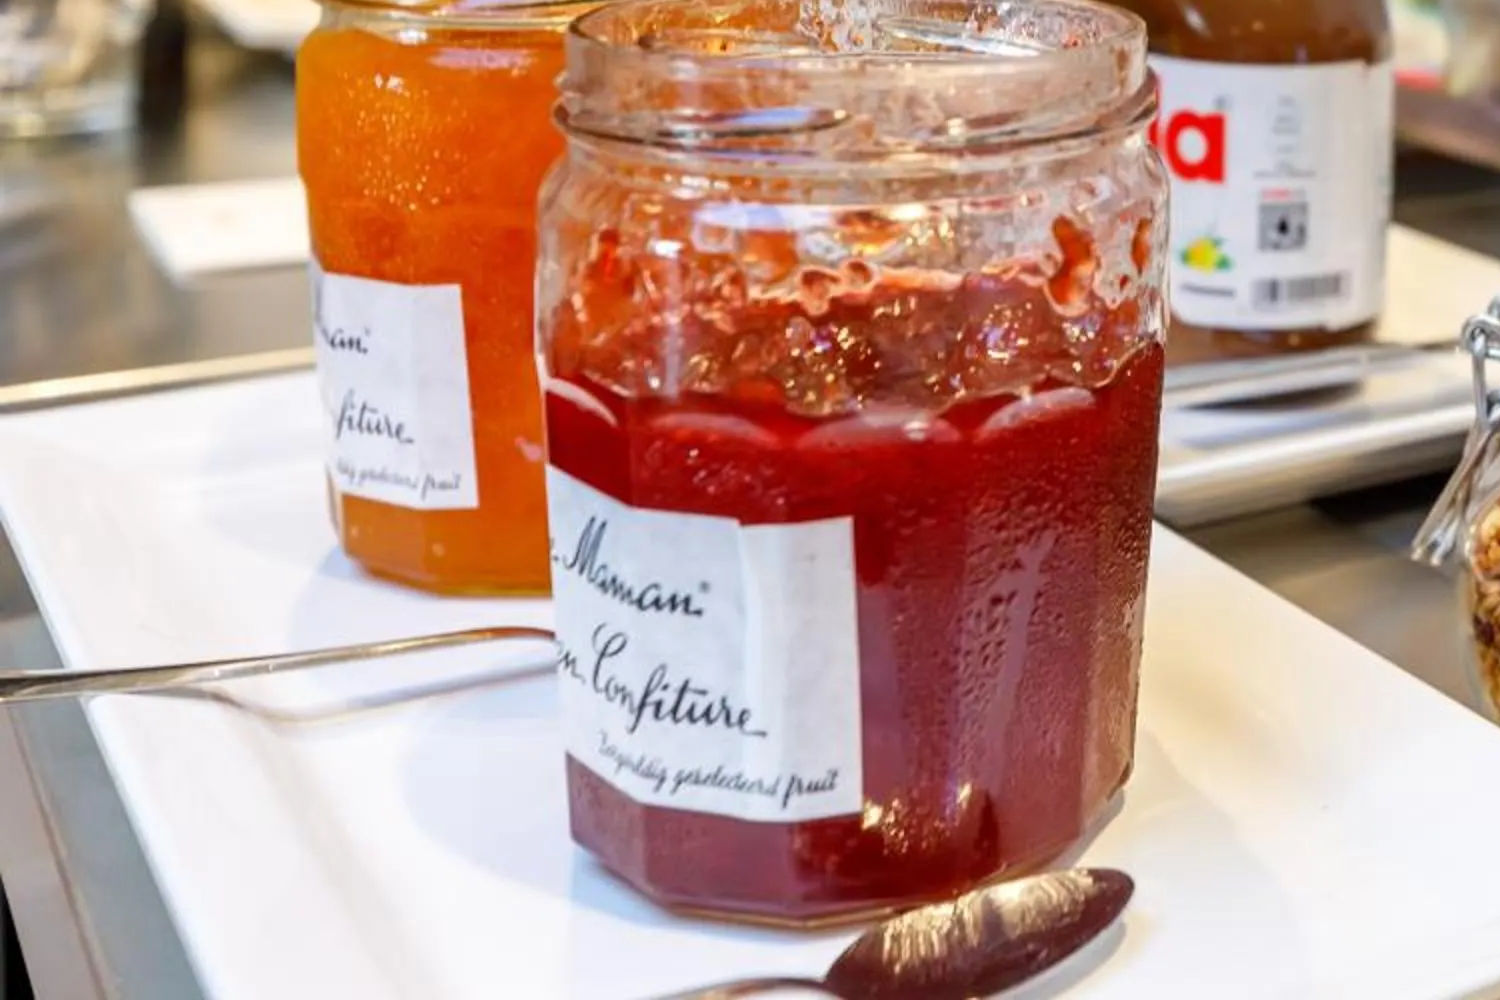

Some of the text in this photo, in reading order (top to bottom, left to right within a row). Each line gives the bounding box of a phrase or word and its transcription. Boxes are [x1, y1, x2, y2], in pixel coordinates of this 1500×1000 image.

[1160, 110, 1225, 184] a
[334, 388, 415, 443] fiture
[592, 623, 767, 735] Confiture
[783, 770, 838, 808] fruit
